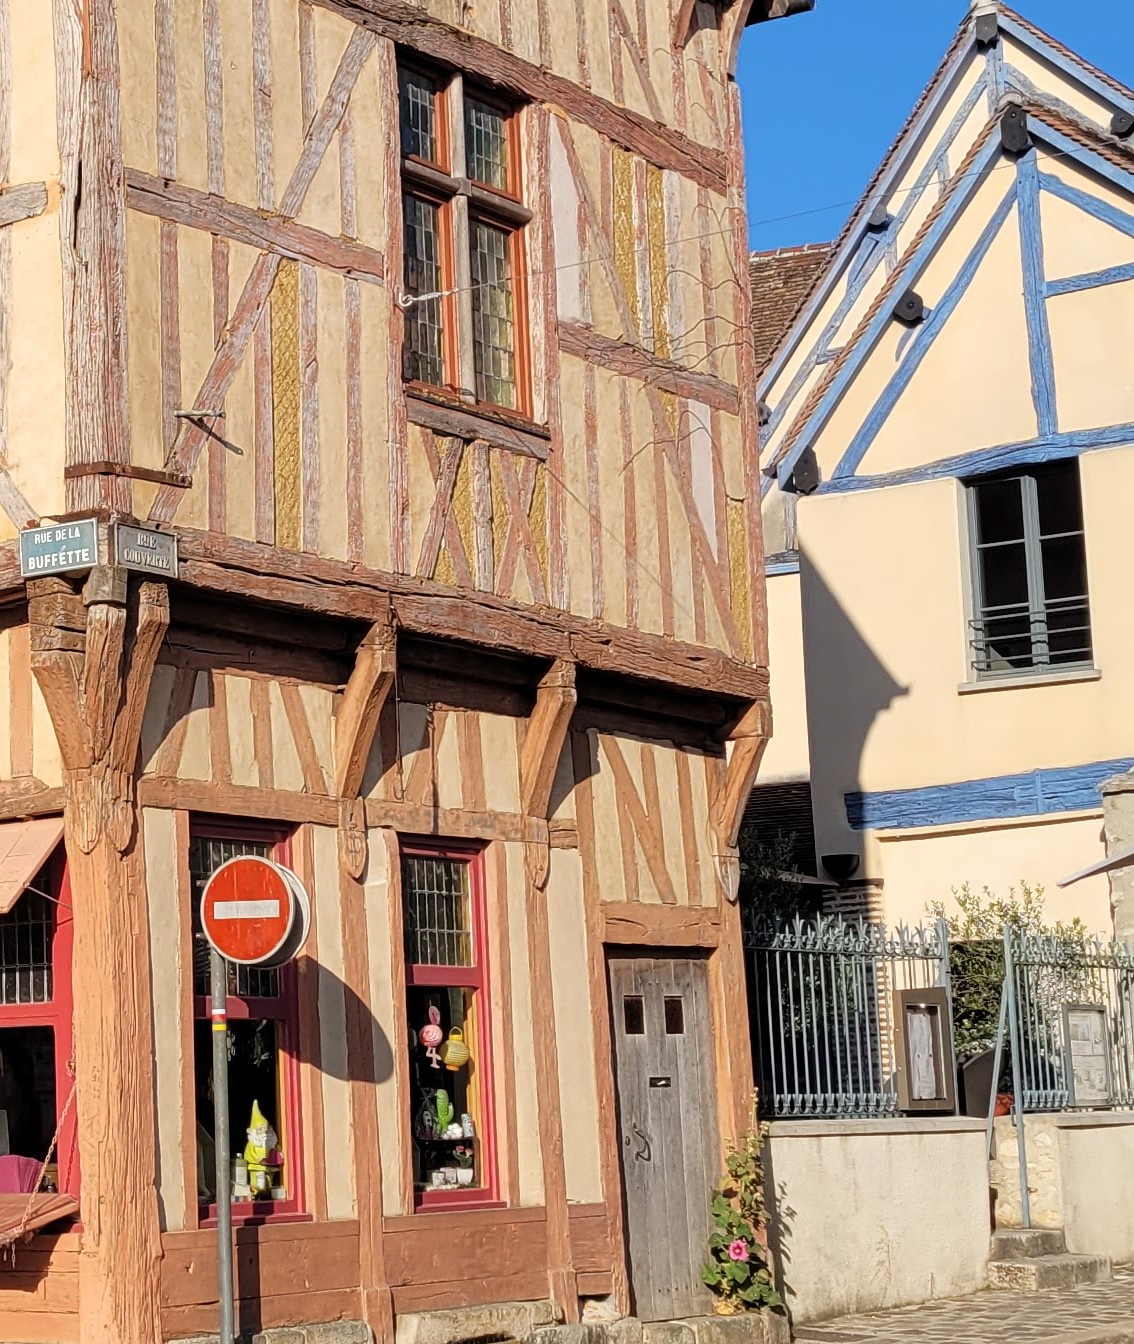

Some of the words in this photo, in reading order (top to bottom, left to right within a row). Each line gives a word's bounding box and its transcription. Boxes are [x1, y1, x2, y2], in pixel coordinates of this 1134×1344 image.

[34, 531, 53, 545] RUE
[56, 528, 67, 542] DE
[68, 526, 81, 539] LA
[137, 532, 157, 549] RUE
[124, 548, 170, 570] COUVERTE
